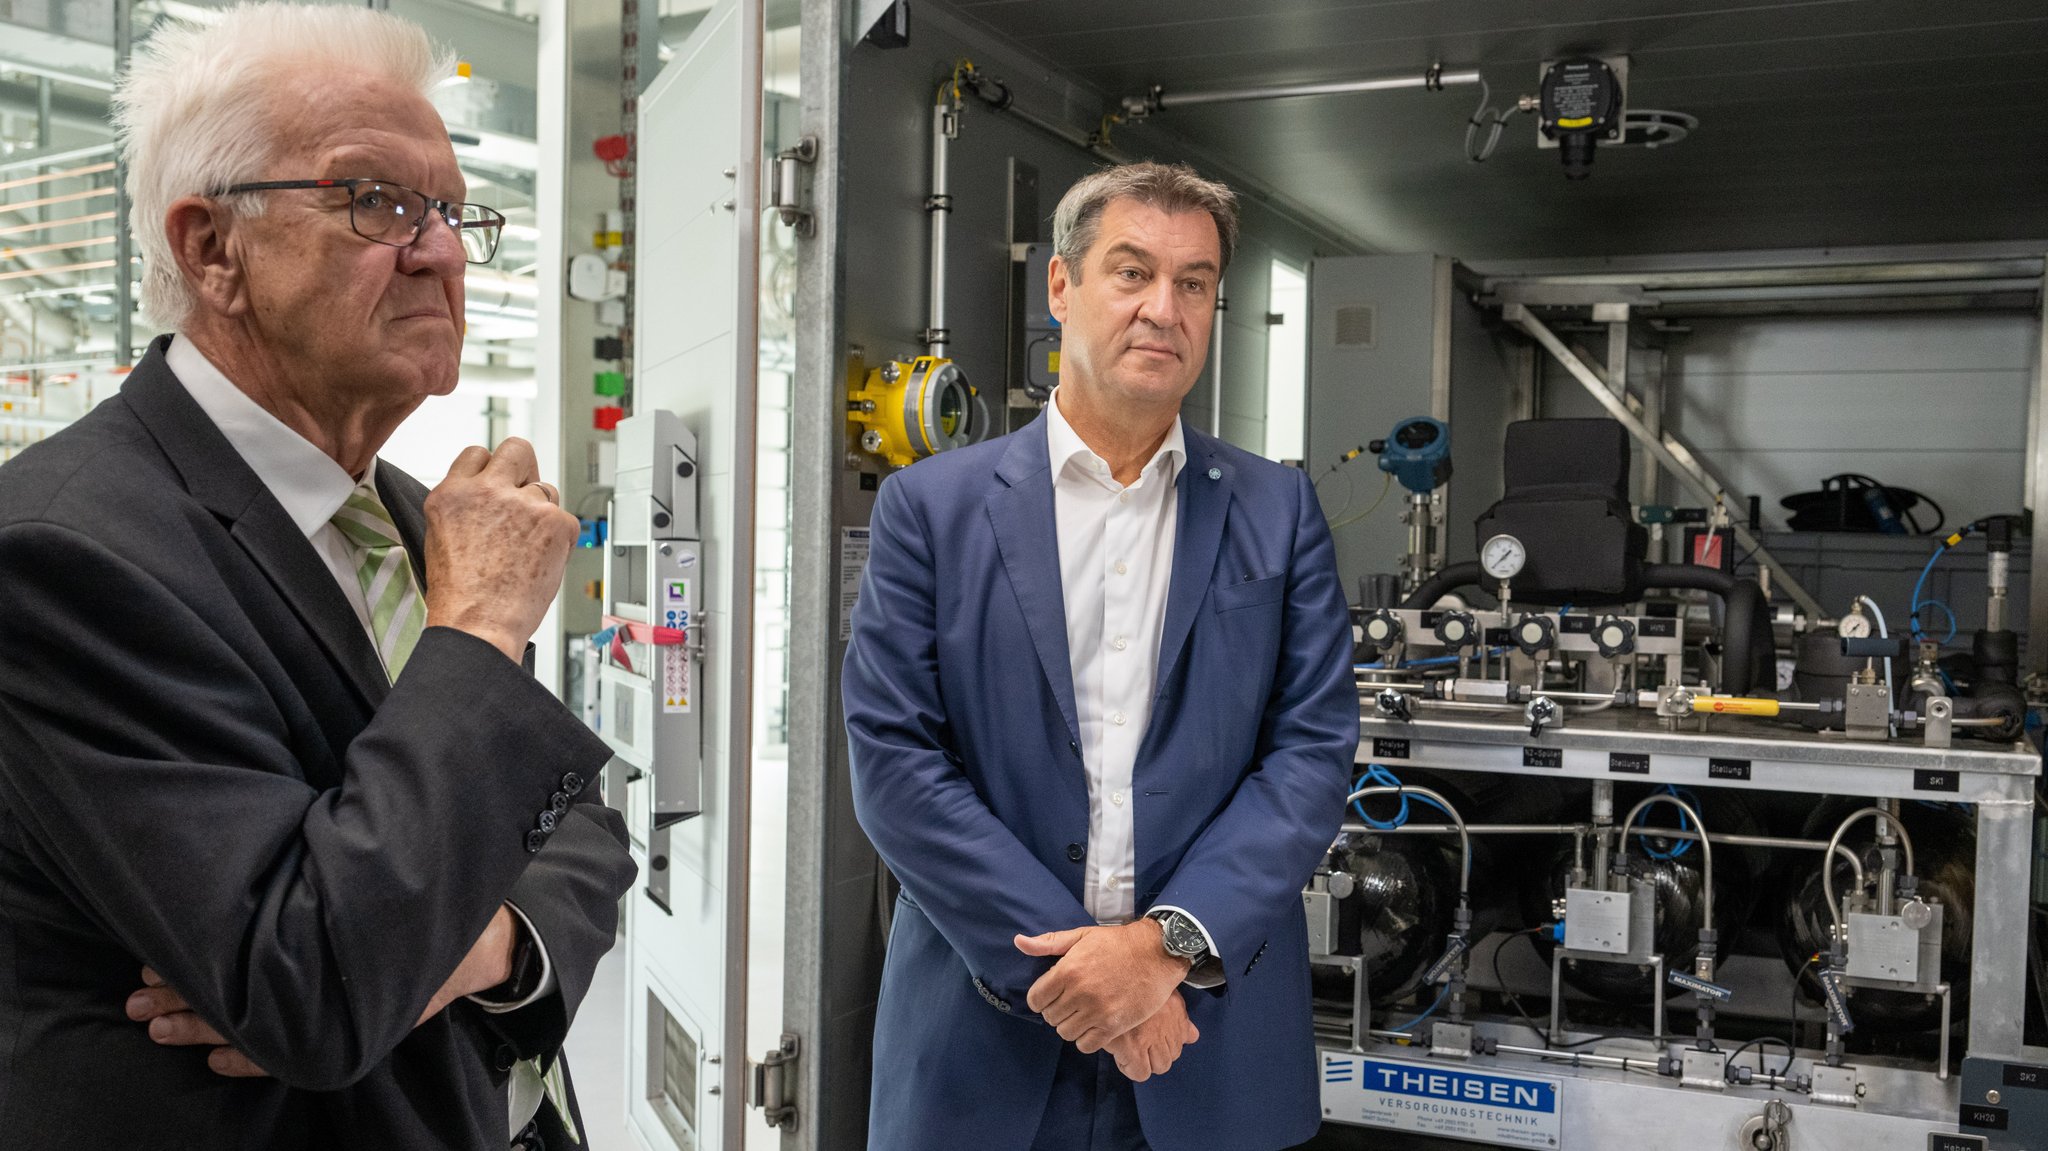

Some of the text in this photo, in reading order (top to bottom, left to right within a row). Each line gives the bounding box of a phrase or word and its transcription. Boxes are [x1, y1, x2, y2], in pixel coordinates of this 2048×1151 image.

[1610, 758, 1649, 770] Stellung 2
[1711, 764, 1742, 776] Stellung
[1929, 776, 1944, 786] SK1
[1673, 976, 1722, 998] MAXIMATOR
[1822, 976, 1849, 1026] MAXIMATOR
[2020, 1072, 2037, 1082] SK2
[1378, 1068, 1539, 1107] THEISEN
[1379, 1097, 1539, 1126] VERSORGUNGSTECHNIK
[1974, 1112, 1996, 1122] KH20
